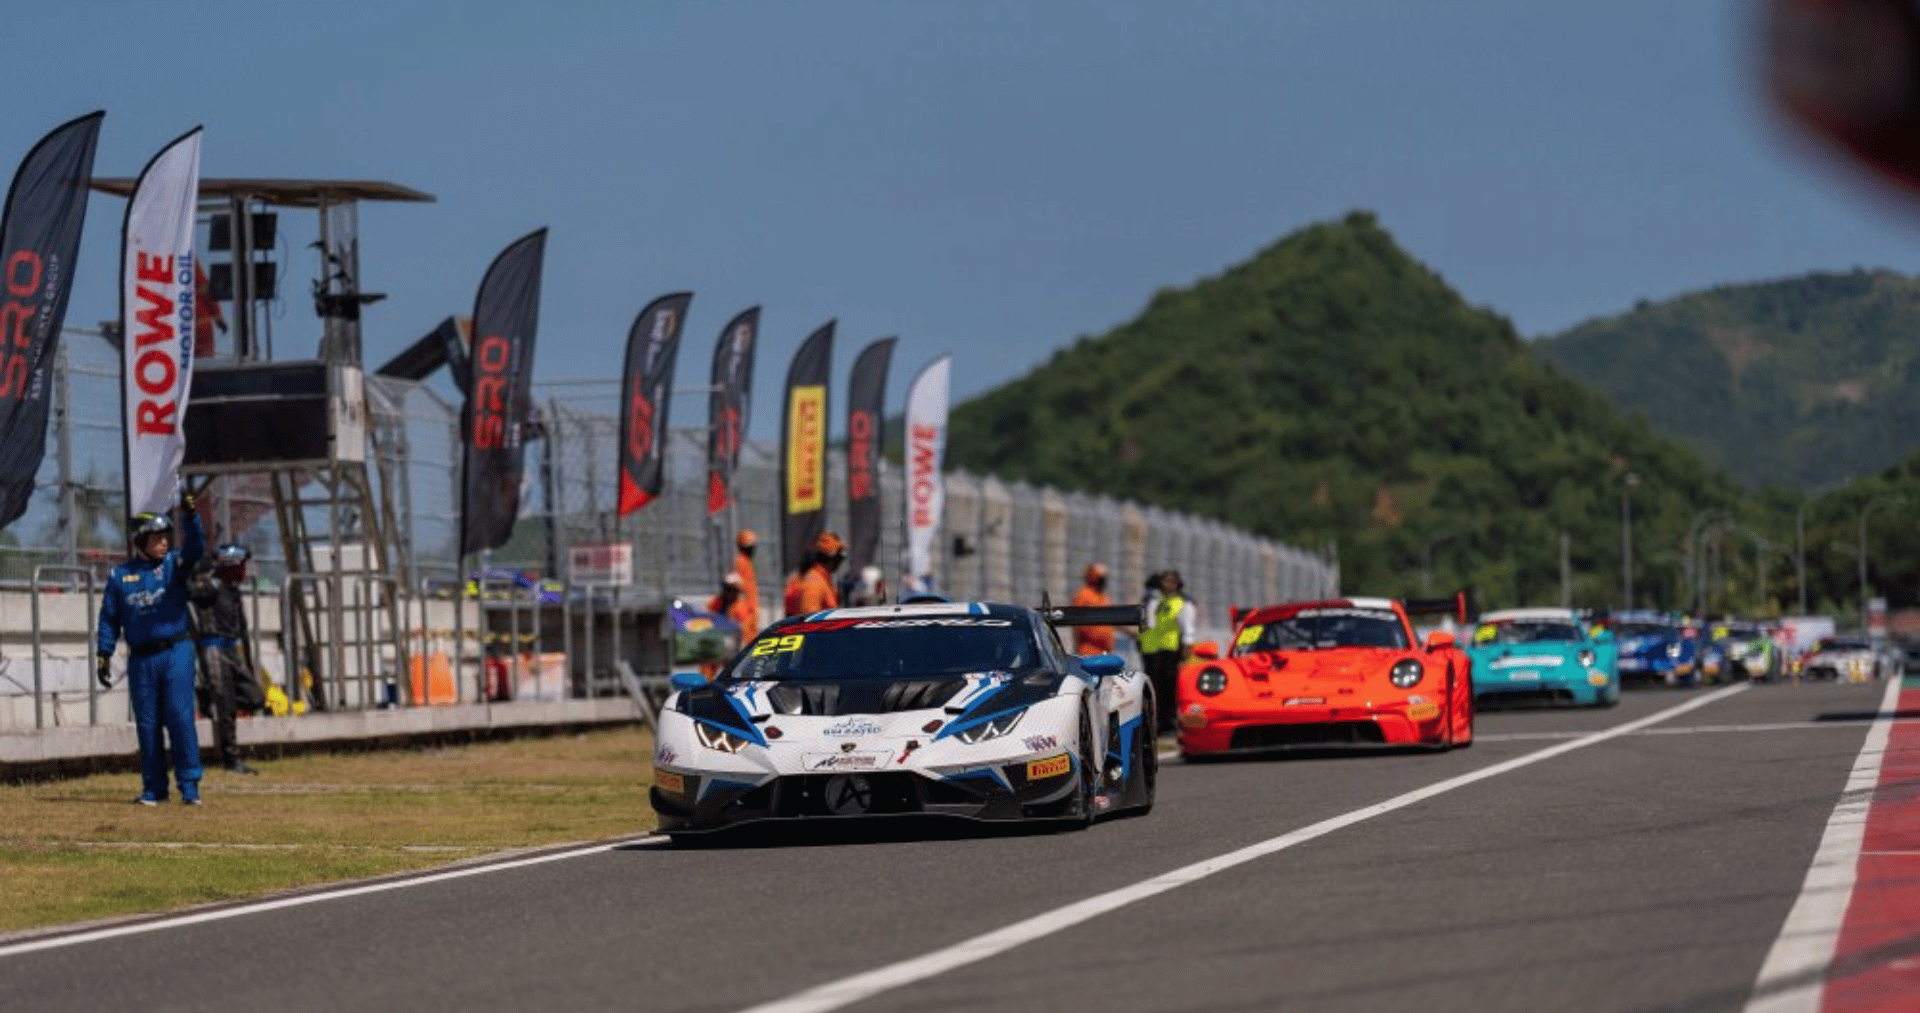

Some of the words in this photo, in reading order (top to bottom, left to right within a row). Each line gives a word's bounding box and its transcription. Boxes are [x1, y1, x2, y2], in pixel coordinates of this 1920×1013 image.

[178, 251, 193, 285] OIL
[135, 251, 177, 436] ROWE
[180, 290, 194, 369] MOTOR
[475, 336, 509, 449] SRO
[752, 635, 805, 656] 29
